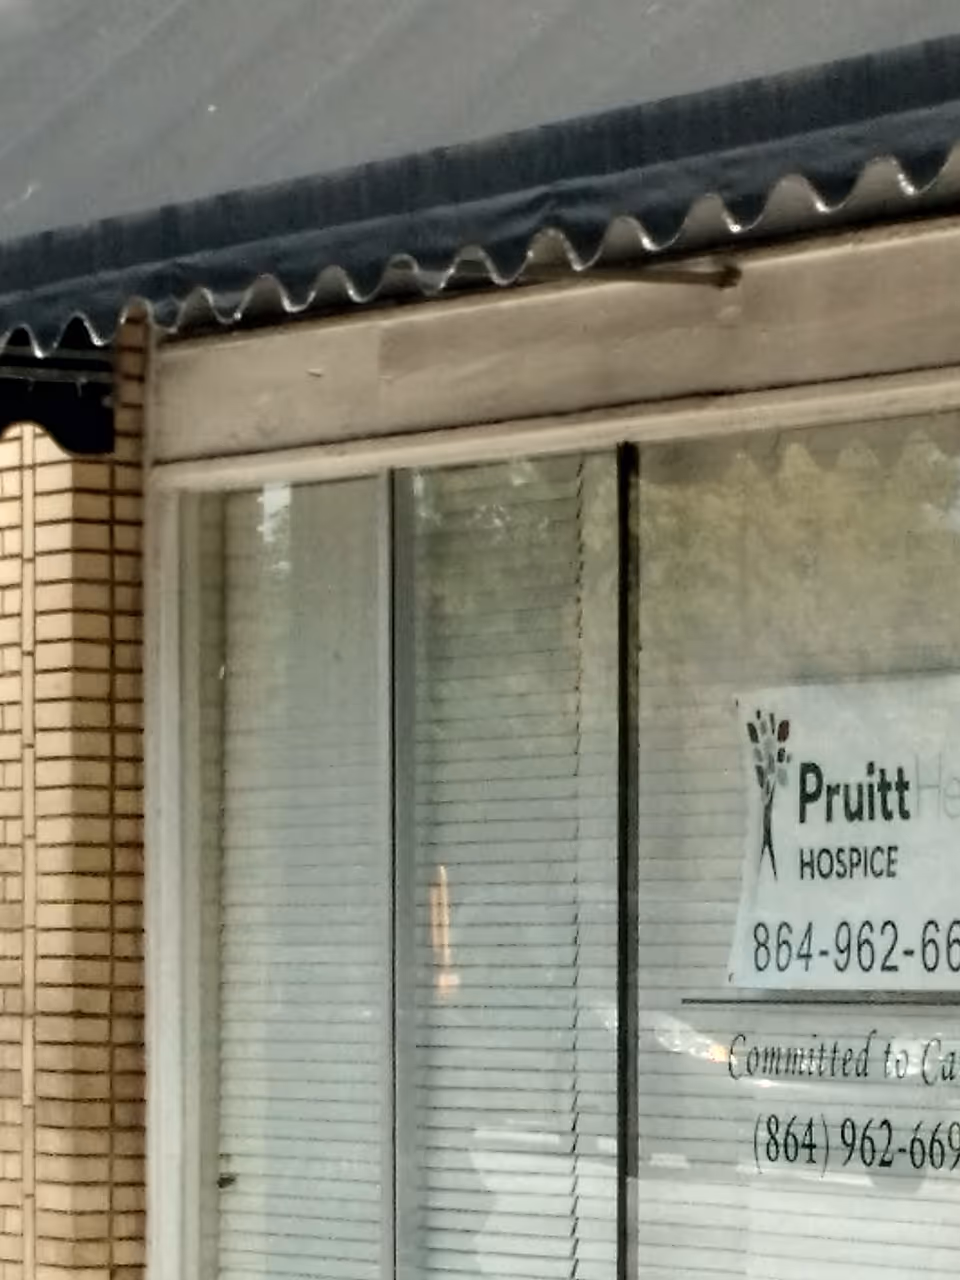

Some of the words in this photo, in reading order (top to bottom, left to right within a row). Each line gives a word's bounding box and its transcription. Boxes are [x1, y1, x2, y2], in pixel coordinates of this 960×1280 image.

[799, 846, 899, 881] HOSPICE
[727, 1028, 878, 1081] Committed
[884, 1042, 909, 1079] to
